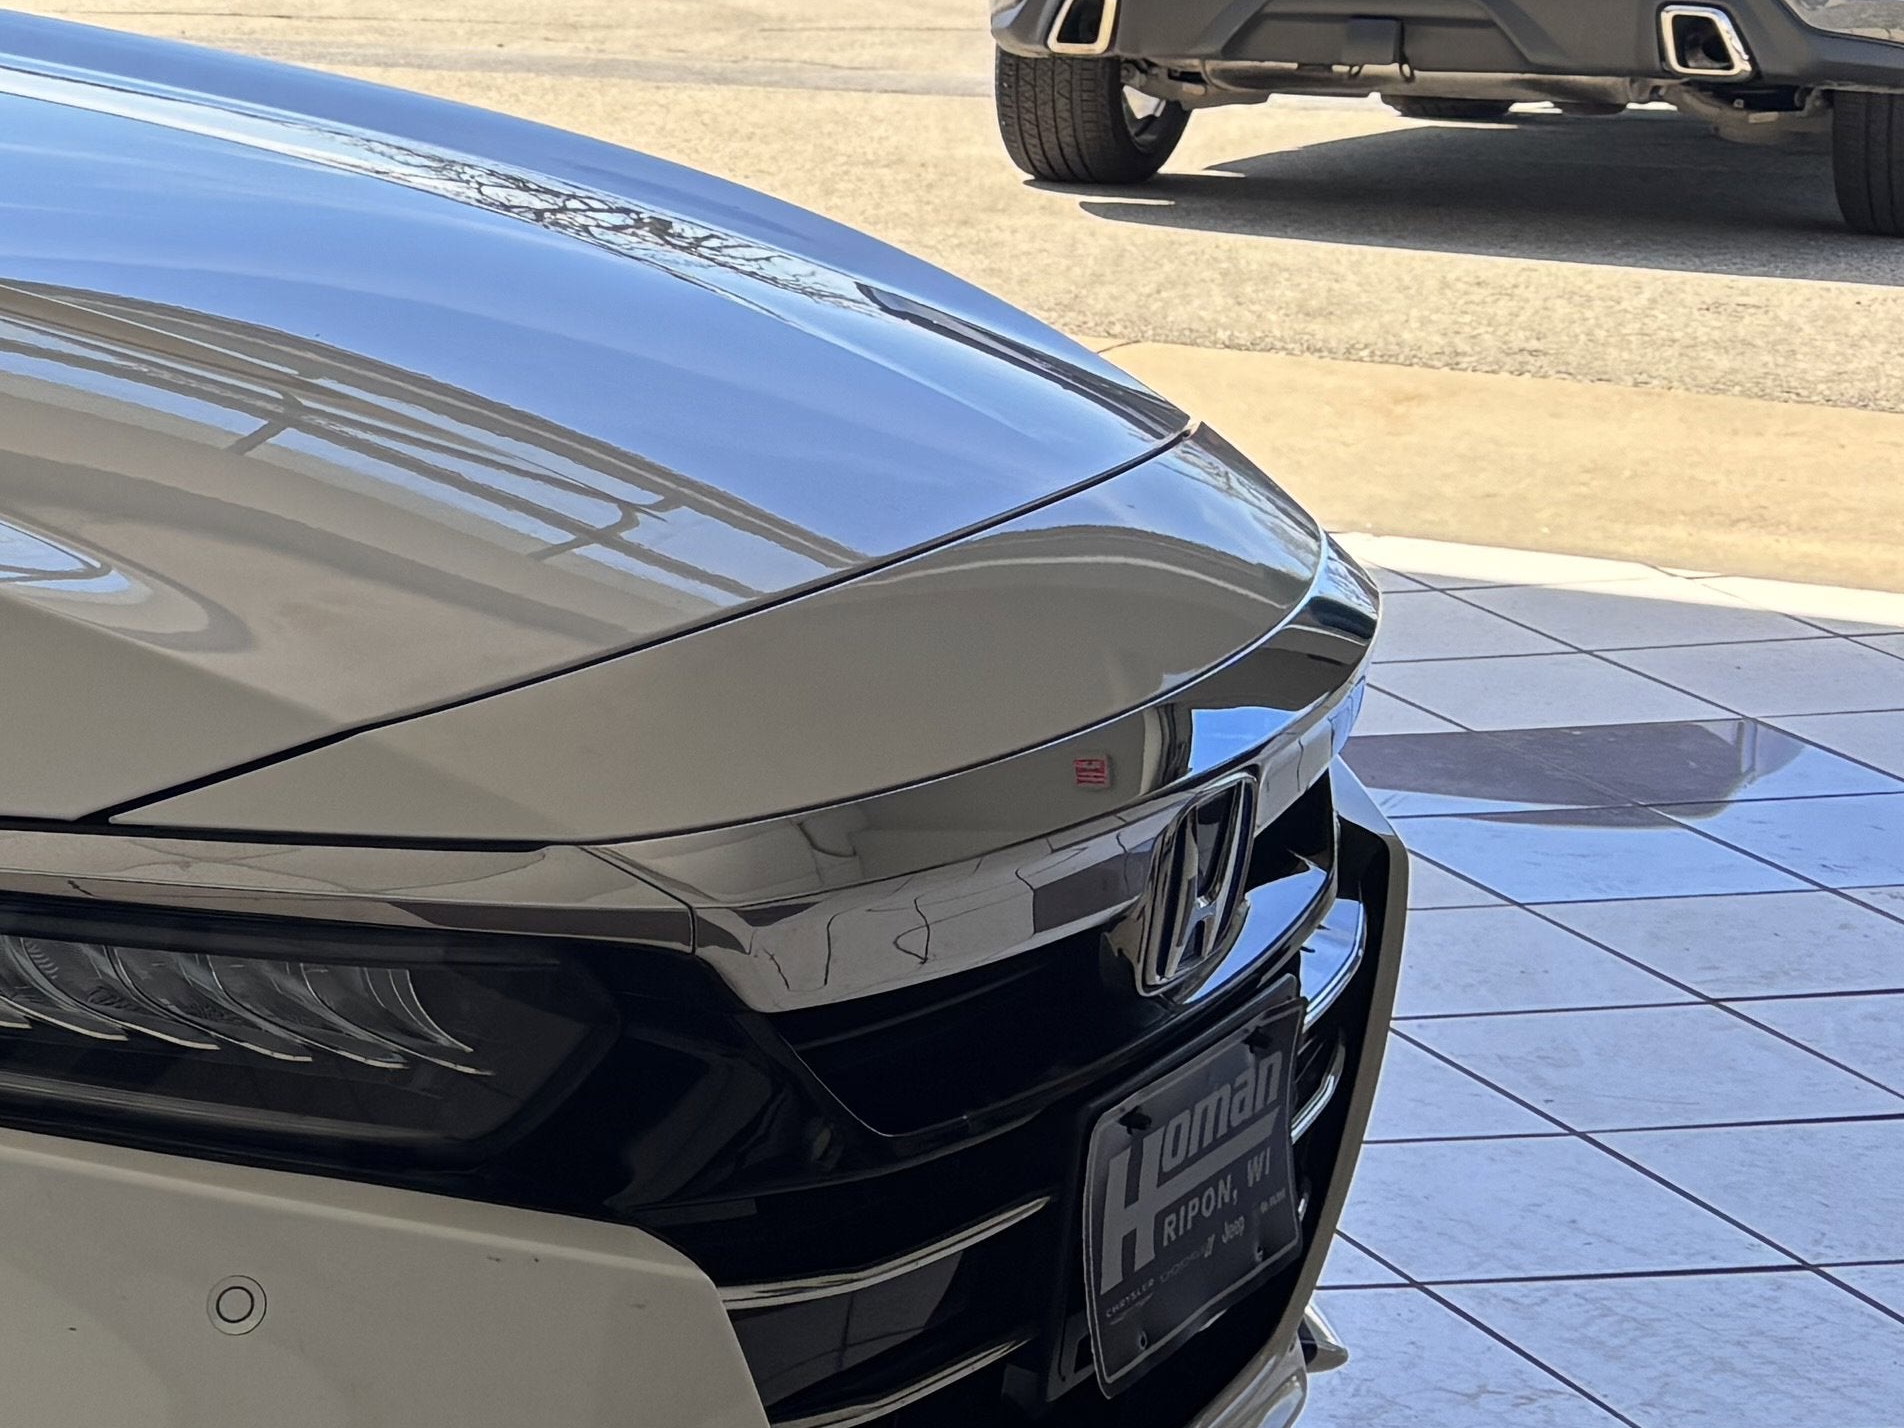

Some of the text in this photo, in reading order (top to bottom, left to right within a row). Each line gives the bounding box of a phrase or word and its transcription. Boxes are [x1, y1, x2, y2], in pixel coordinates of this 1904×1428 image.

[1099, 1050, 1284, 1297] Homan
[1162, 1146, 1272, 1247] RIPON, WI
[1222, 1215, 1245, 1244] Jeep
